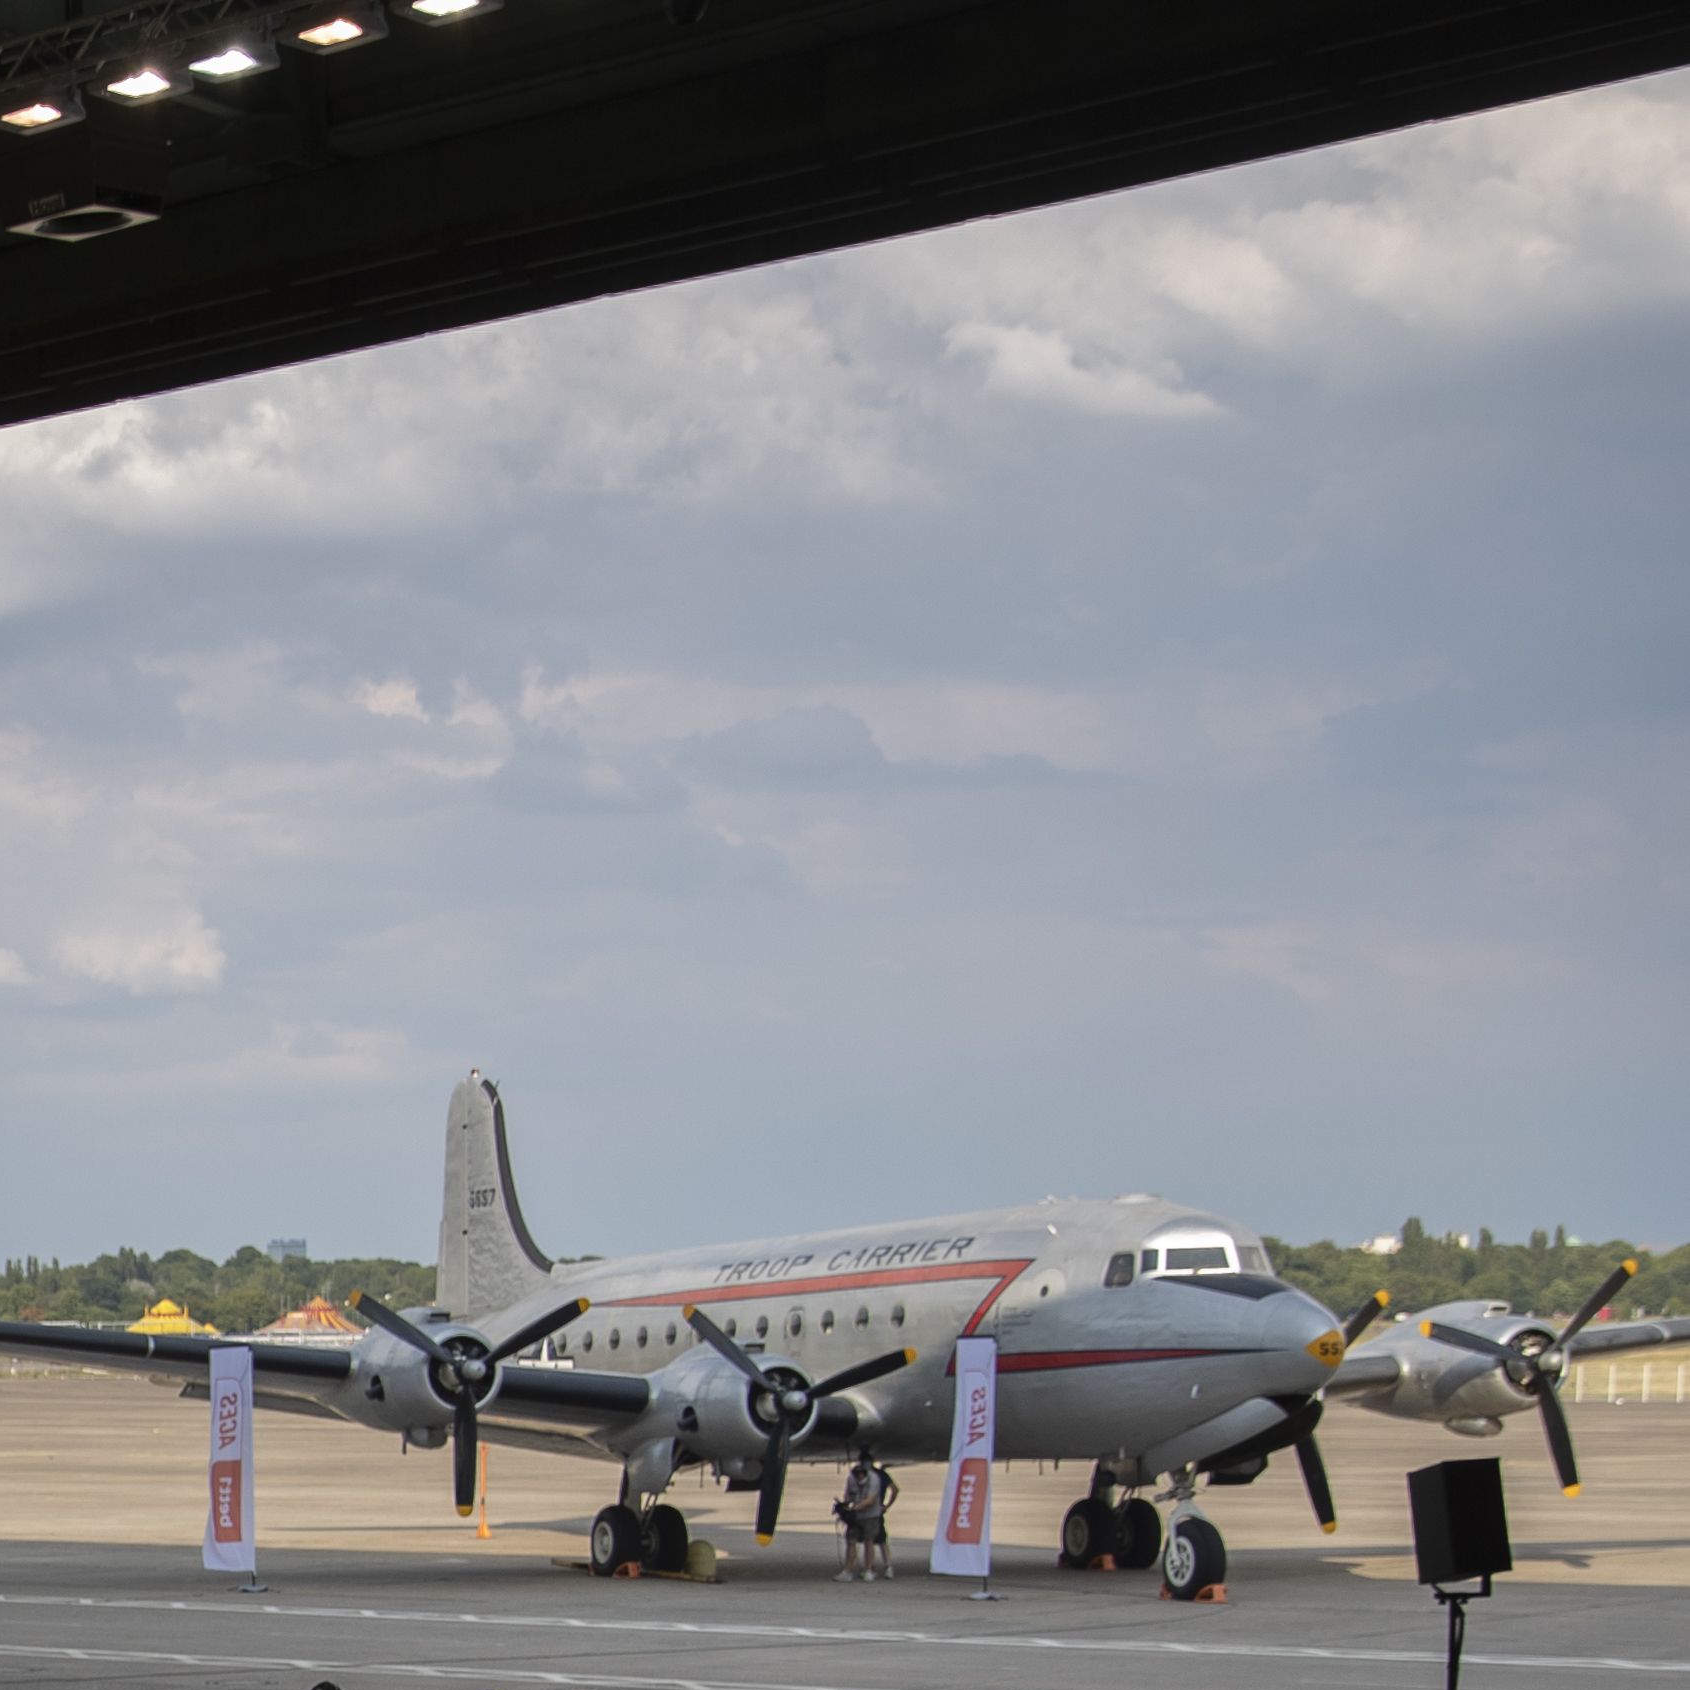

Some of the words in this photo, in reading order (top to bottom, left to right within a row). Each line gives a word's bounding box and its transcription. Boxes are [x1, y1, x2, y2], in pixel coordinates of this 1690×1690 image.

[713, 1255, 815, 1284] TROOP
[826, 1236, 976, 1273] CARRIER
[1319, 1341, 1344, 1357] 55
